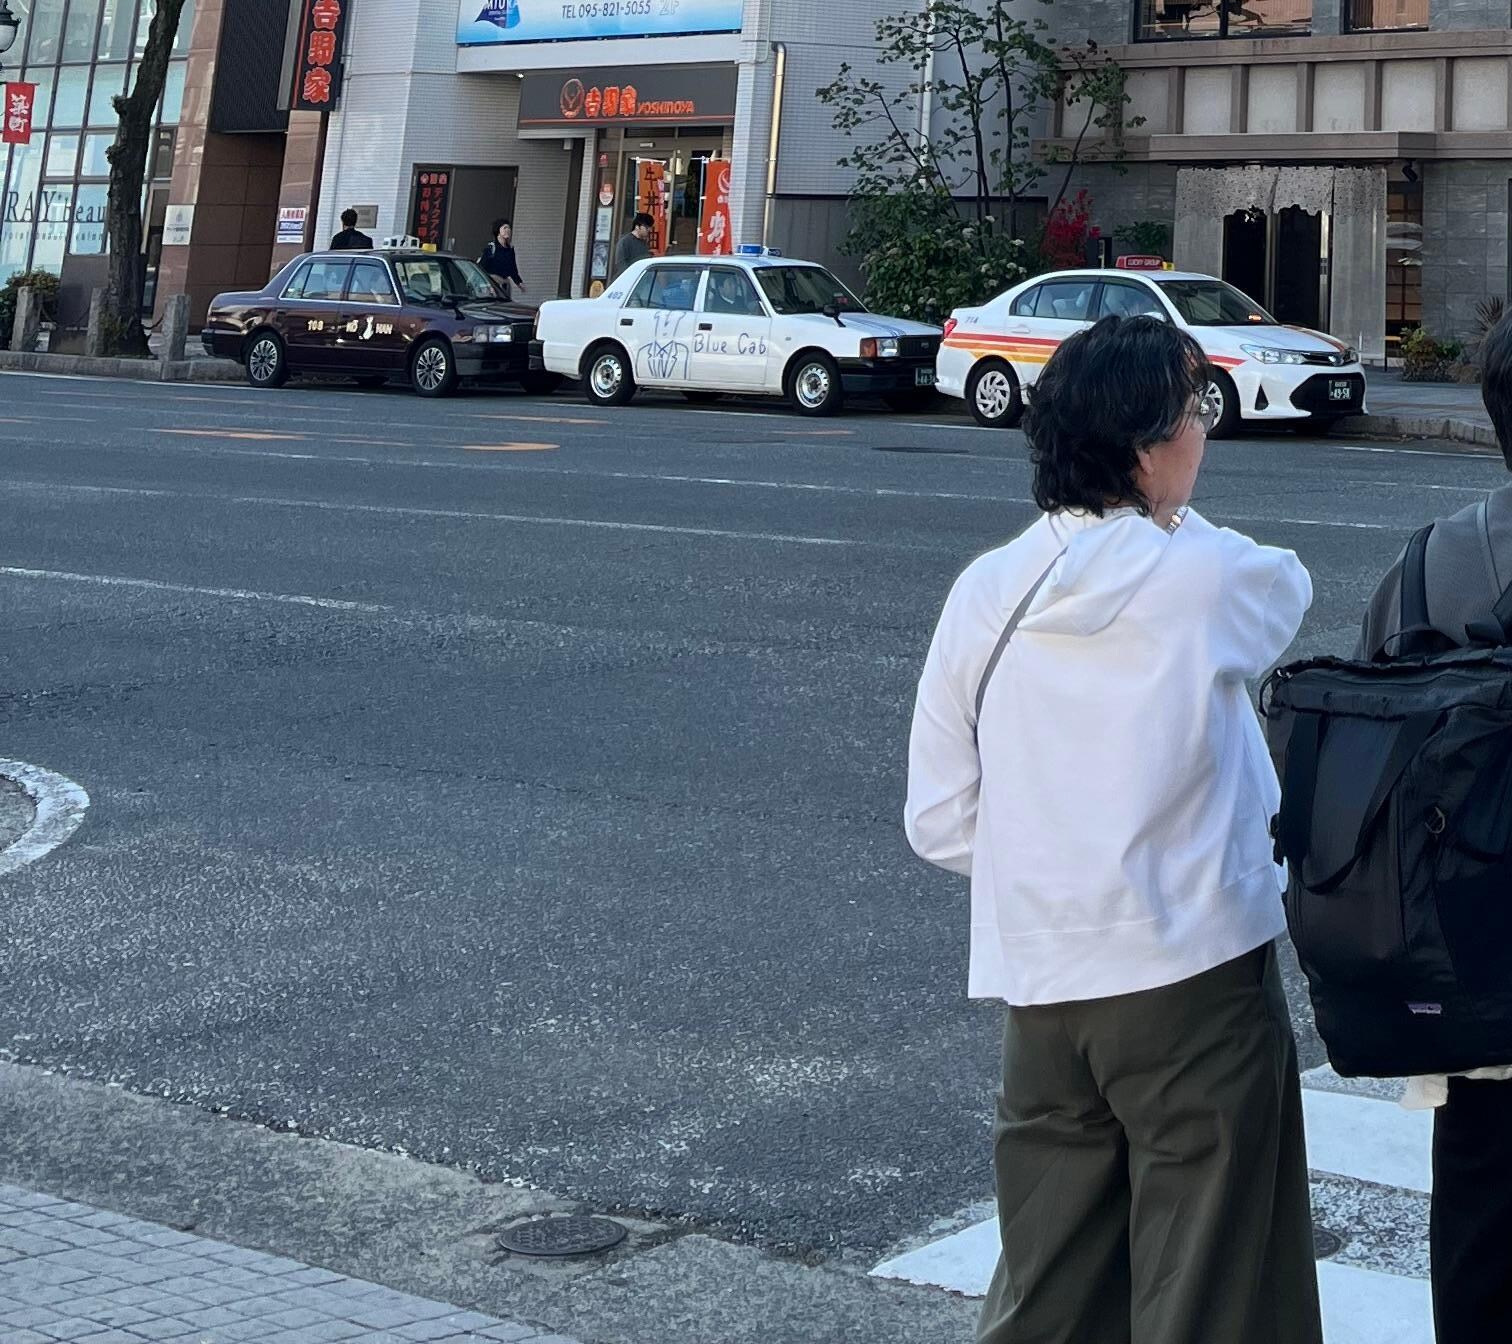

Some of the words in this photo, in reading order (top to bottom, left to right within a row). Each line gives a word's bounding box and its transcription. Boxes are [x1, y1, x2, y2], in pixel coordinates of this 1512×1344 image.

[561, 4, 577, 19] TEL
[578, 0, 651, 18] 095-821-5055
[584, 85, 637, 118] 吉野家
[693, 332, 728, 354] Blue
[737, 332, 768, 355] Cab
